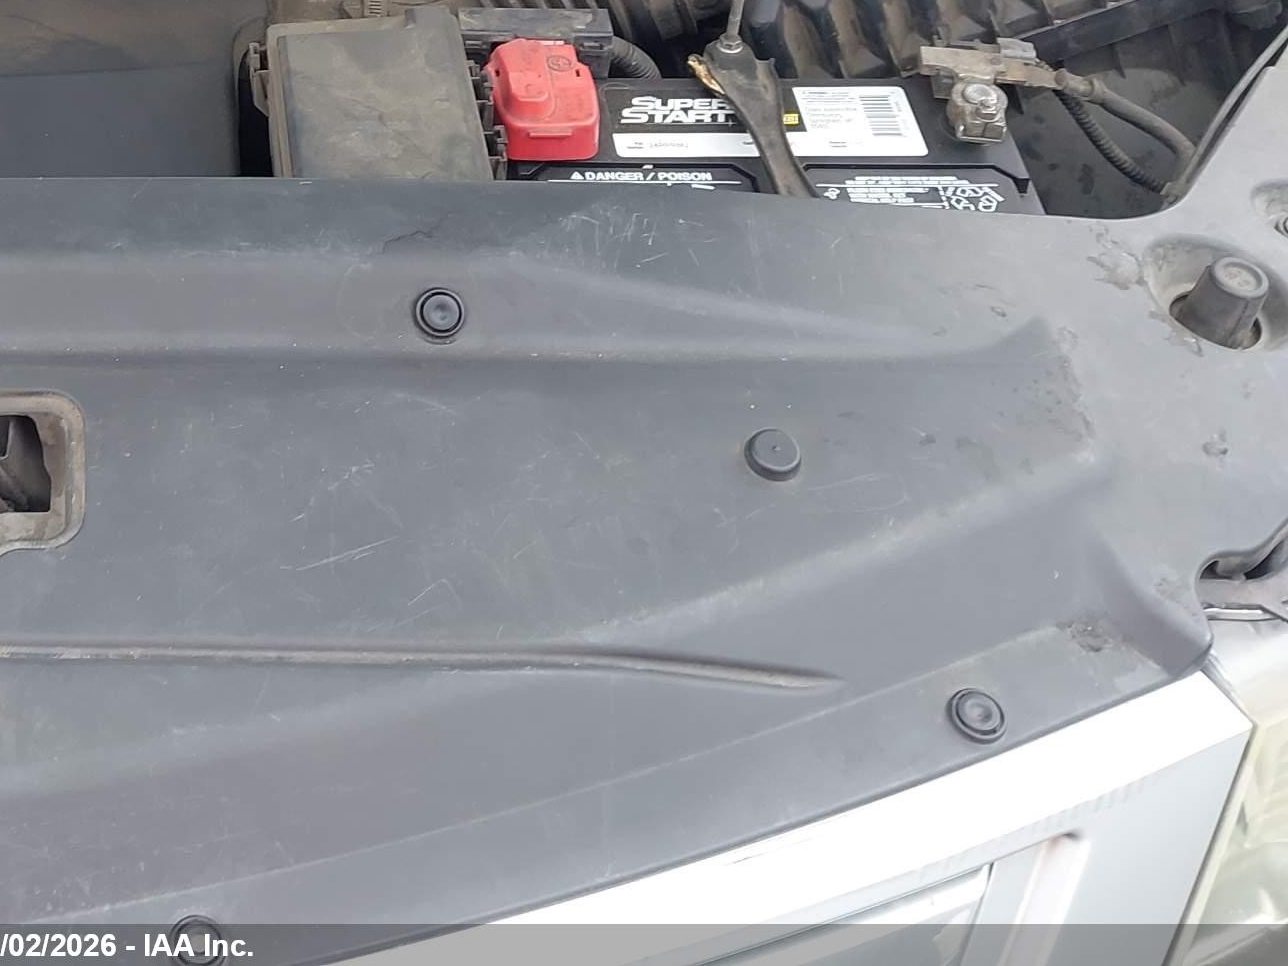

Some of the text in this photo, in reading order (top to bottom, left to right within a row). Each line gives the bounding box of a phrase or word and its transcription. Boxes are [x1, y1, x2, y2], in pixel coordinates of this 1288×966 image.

[631, 95, 731, 110] SUPER
[620, 107, 735, 124] START
[584, 171, 644, 181] DANGER
[657, 171, 713, 181] POISON
